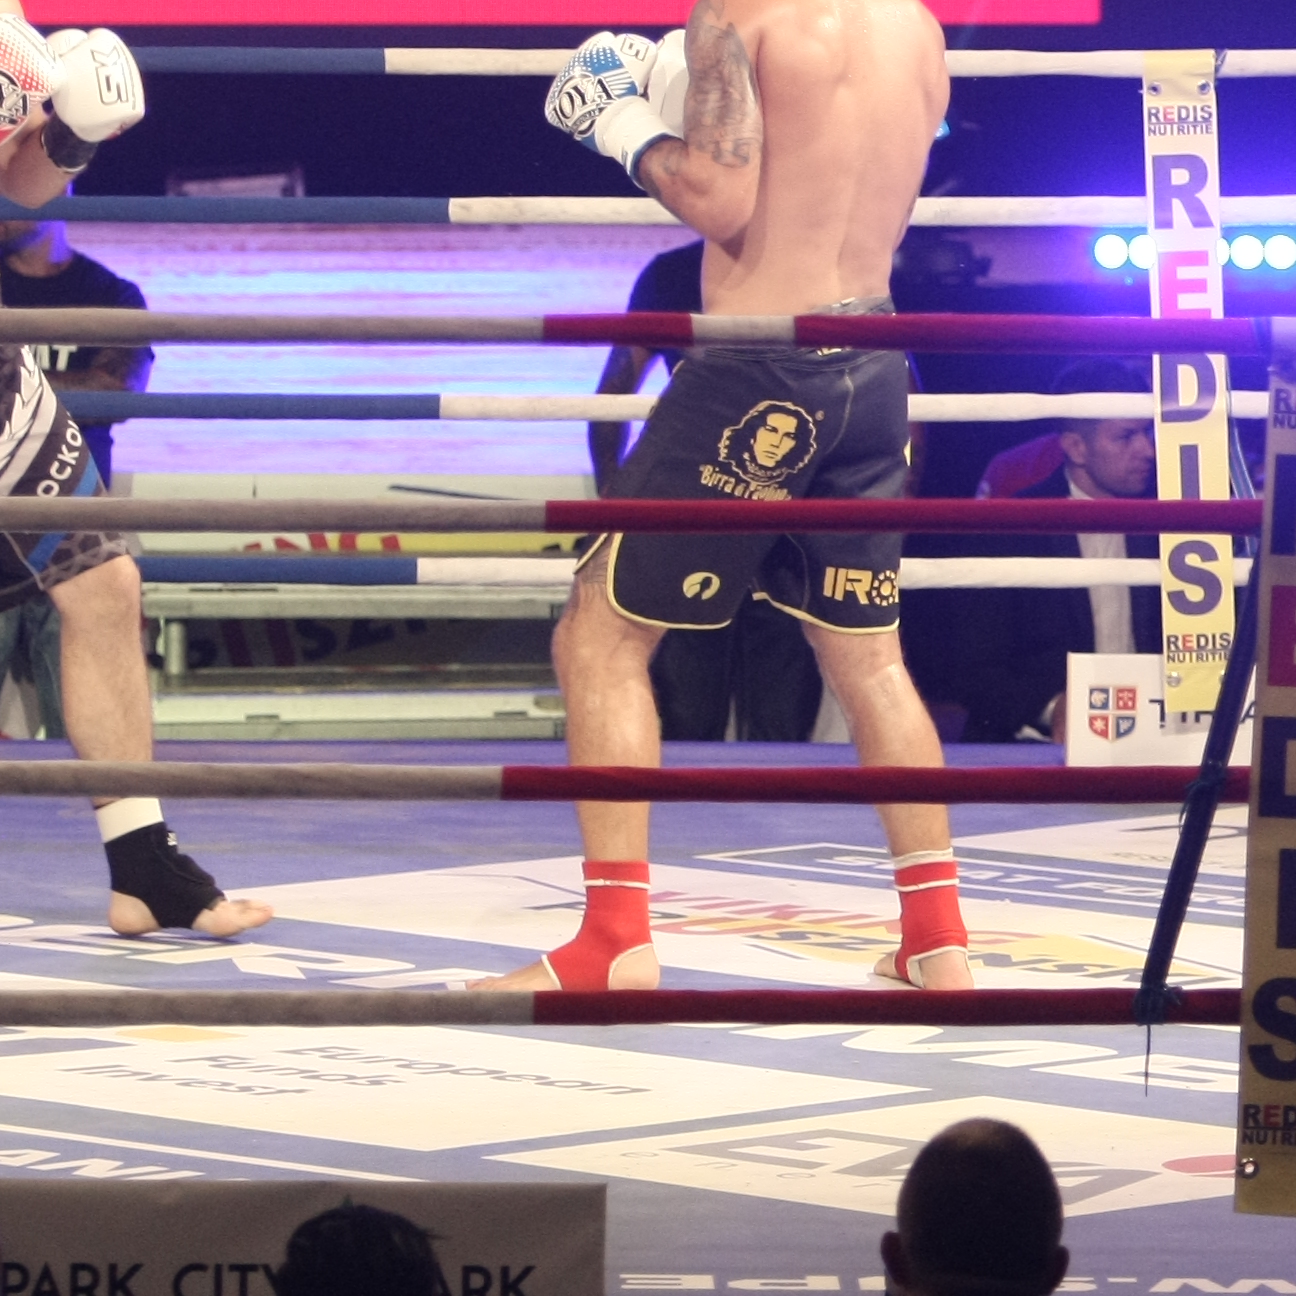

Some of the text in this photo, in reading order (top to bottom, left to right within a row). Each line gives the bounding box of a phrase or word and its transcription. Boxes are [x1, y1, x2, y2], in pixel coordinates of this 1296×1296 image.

[1148, 105, 1213, 123] REDIS
[1148, 122, 1214, 136] NUTRITIE
[1152, 153, 1223, 616] REDIS
[1166, 633, 1231, 652] REDIS
[56, 1063, 319, 1098] Invest
[165, 1053, 411, 1089] Funds
[277, 1044, 656, 1097] European
